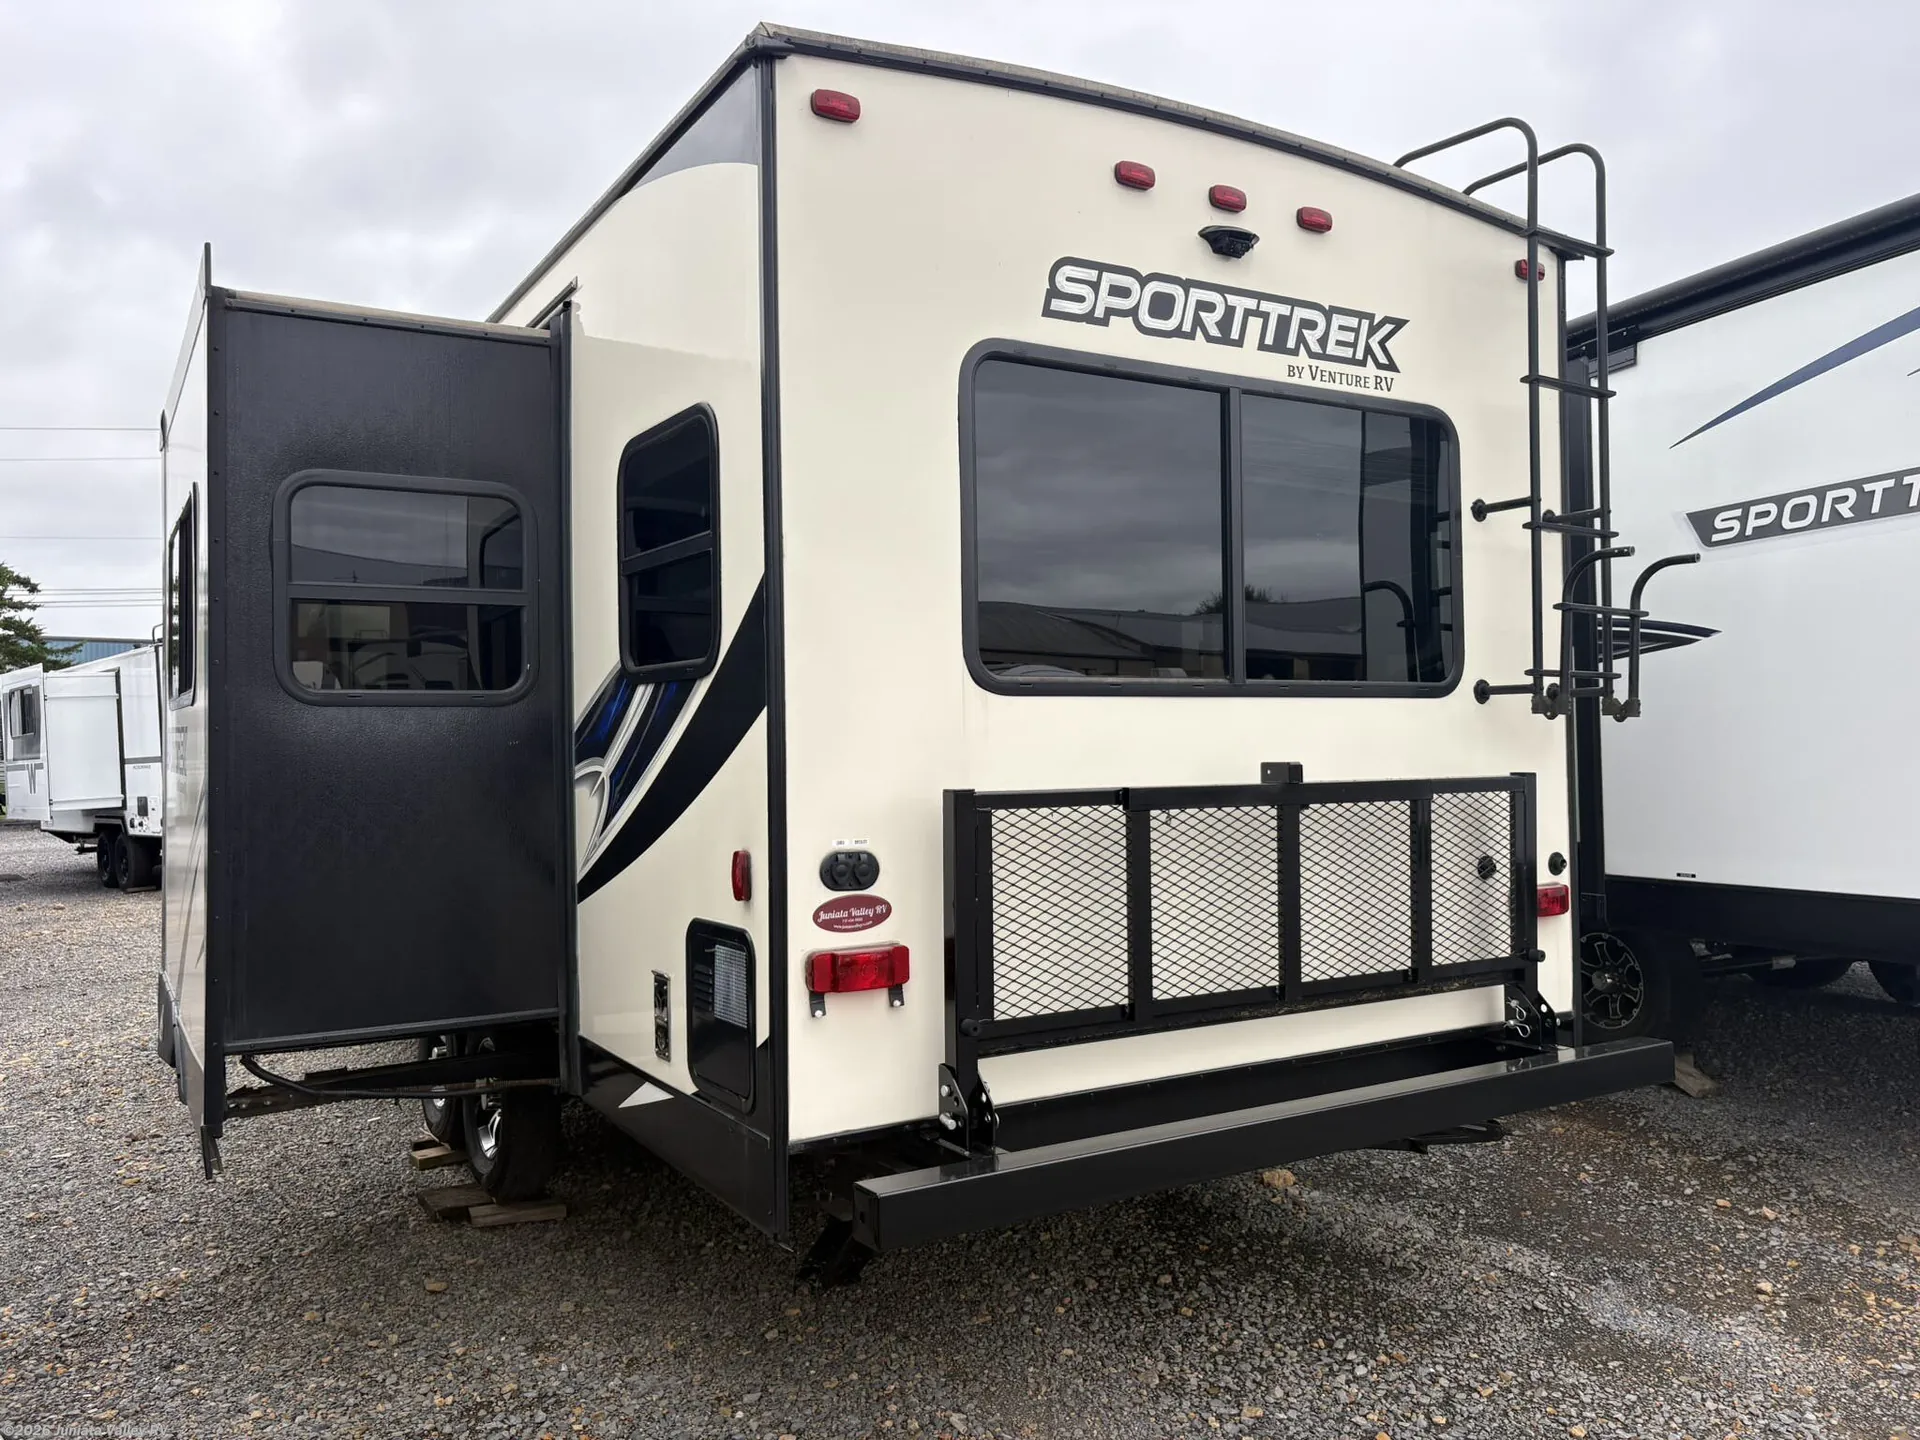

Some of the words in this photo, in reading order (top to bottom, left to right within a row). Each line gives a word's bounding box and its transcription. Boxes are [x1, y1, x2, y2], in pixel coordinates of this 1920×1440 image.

[1046, 260, 1402, 370] SPORTTREK
[1287, 364, 1304, 379] BY
[1373, 375, 1394, 392] RV
[817, 910, 849, 923] Juniata
[849, 906, 874, 918] Valley
[875, 904, 888, 914] RV
